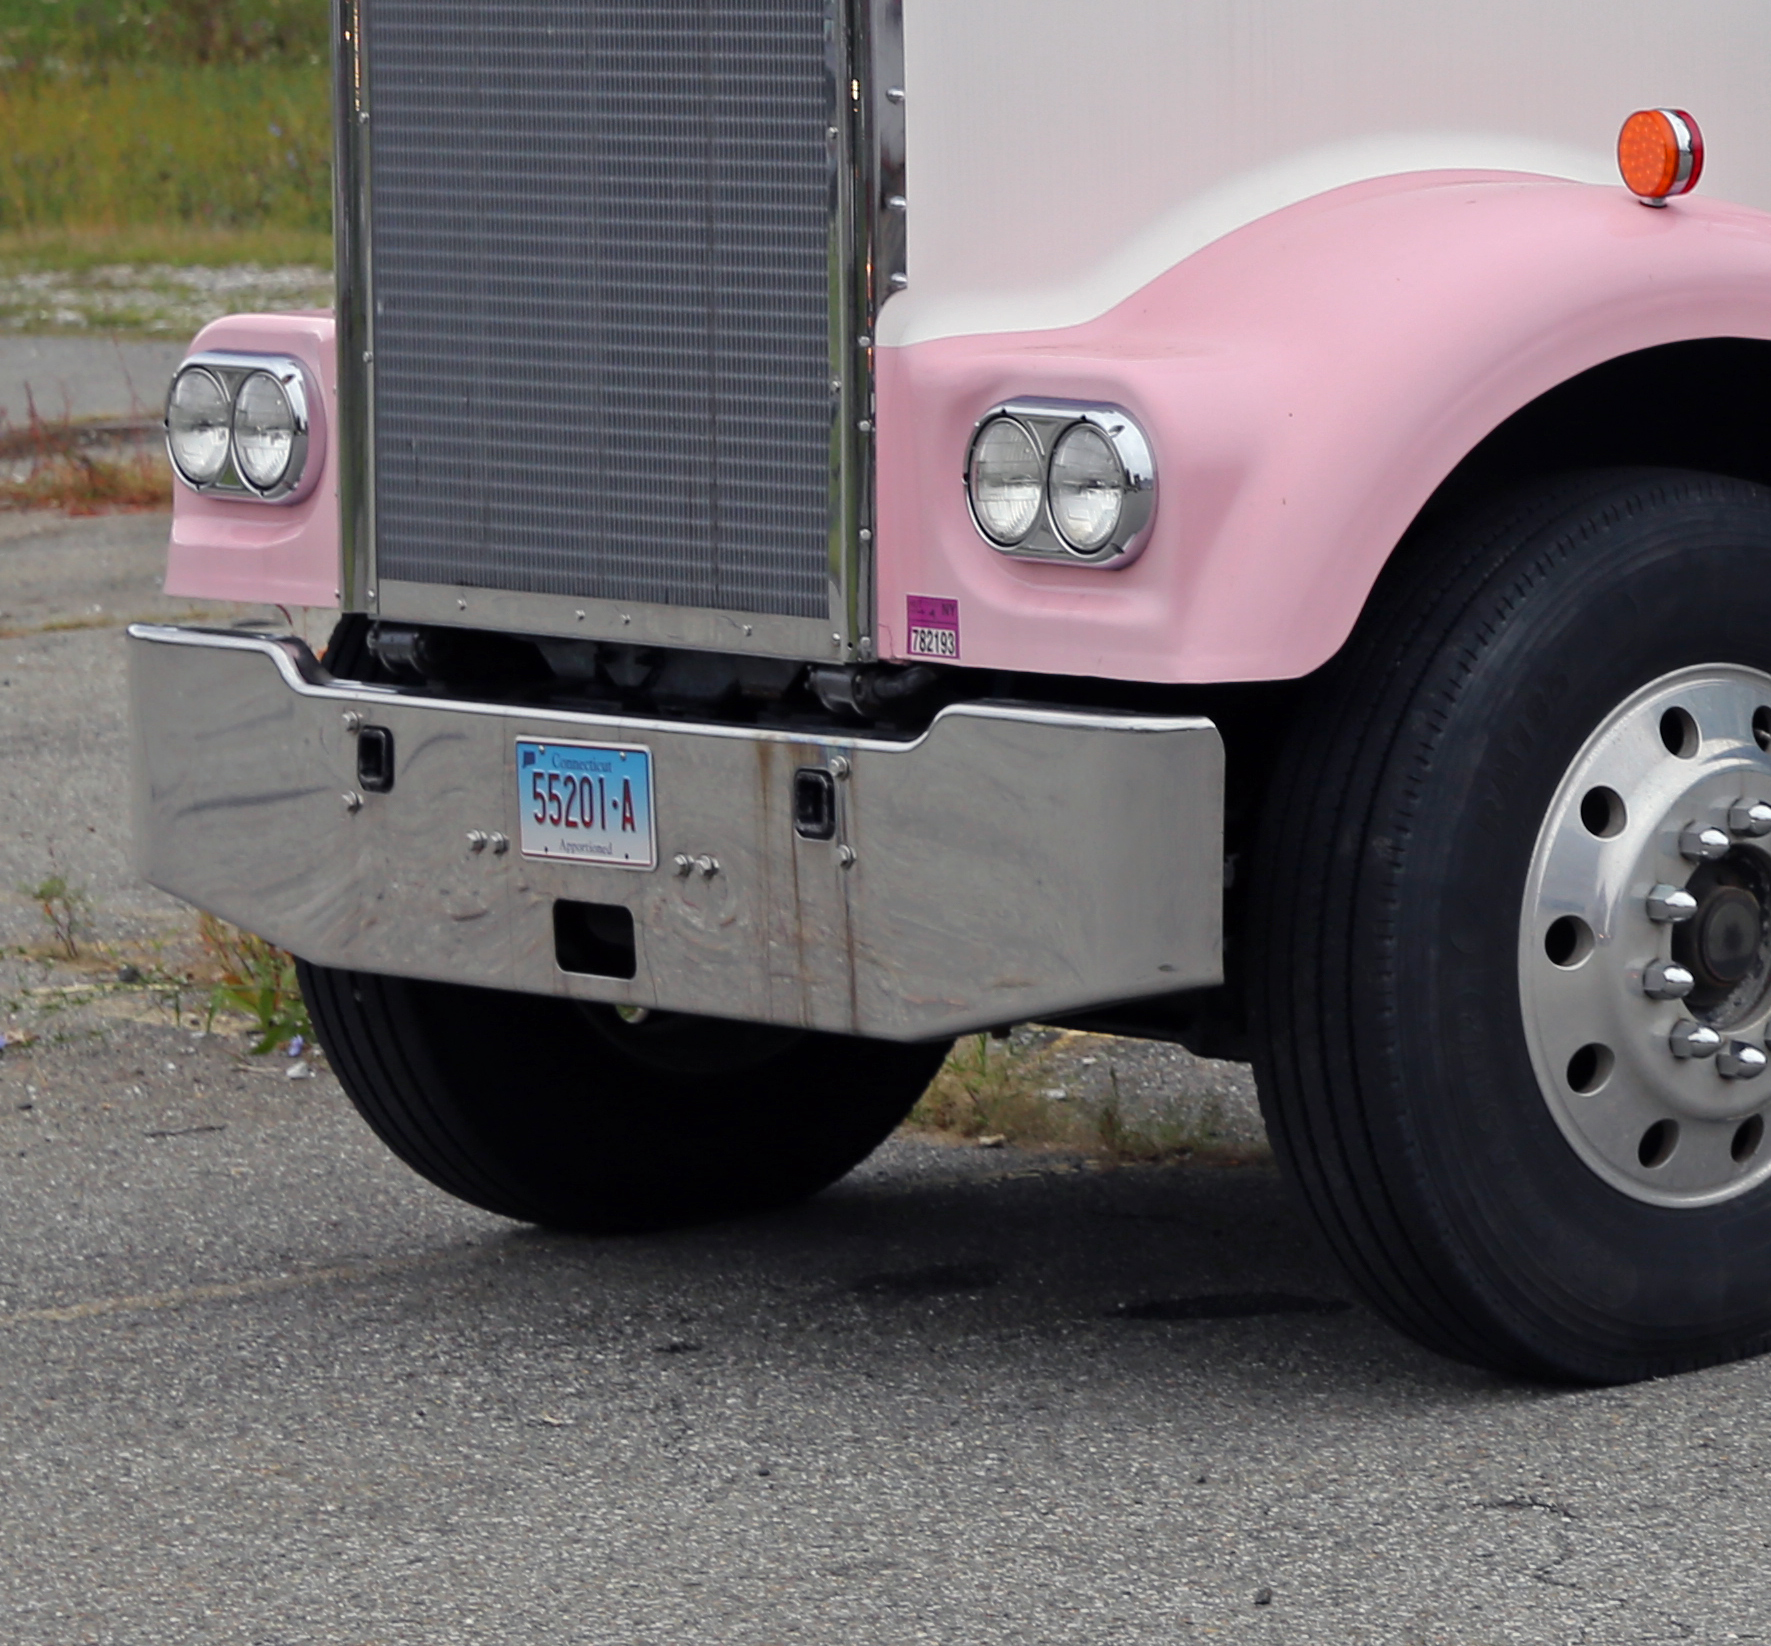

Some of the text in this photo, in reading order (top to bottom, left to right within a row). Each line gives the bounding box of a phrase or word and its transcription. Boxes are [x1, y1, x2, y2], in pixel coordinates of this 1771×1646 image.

[912, 628, 955, 656] 782193
[552, 753, 612, 773] Connecticut
[559, 837, 613, 856] Apportioned
